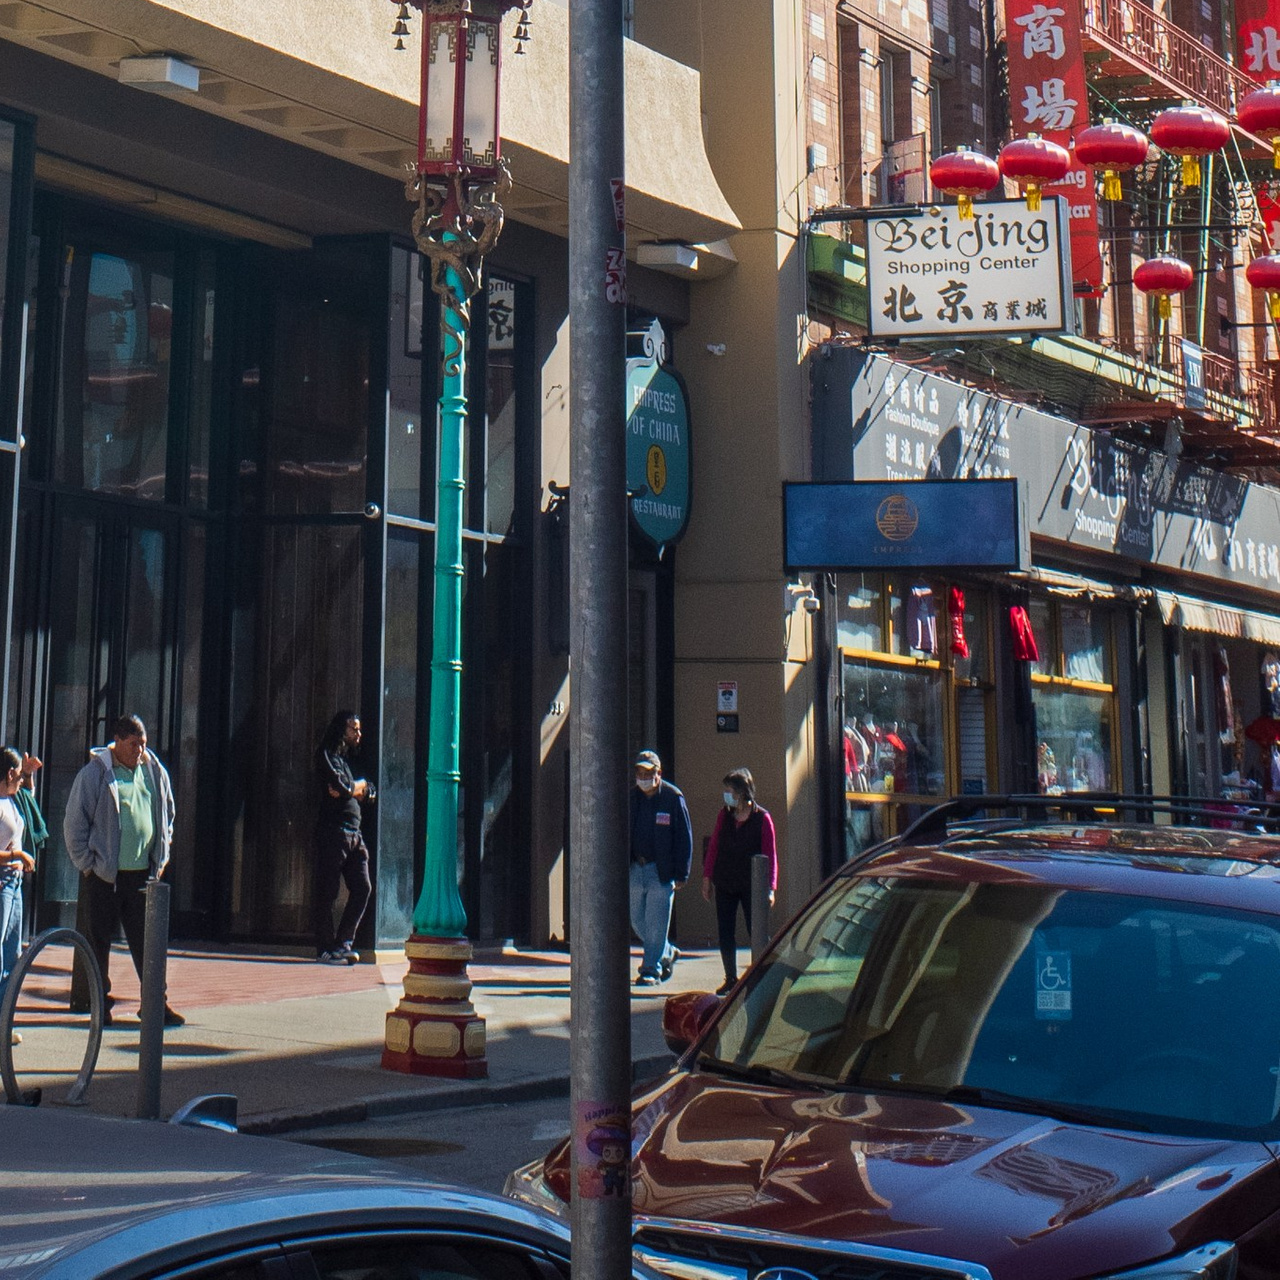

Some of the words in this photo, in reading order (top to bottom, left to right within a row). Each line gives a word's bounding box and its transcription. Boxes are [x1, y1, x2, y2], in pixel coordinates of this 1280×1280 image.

[887, 259, 970, 276] Shopping
[980, 256, 1039, 271] Center
[633, 384, 676, 414] EMPRESS
[632, 414, 645, 436] OF
[884, 403, 911, 428] Fashion
[911, 412, 940, 437] Boutique
[1074, 508, 1117, 545] Shopping
[1120, 522, 1151, 547] Center
